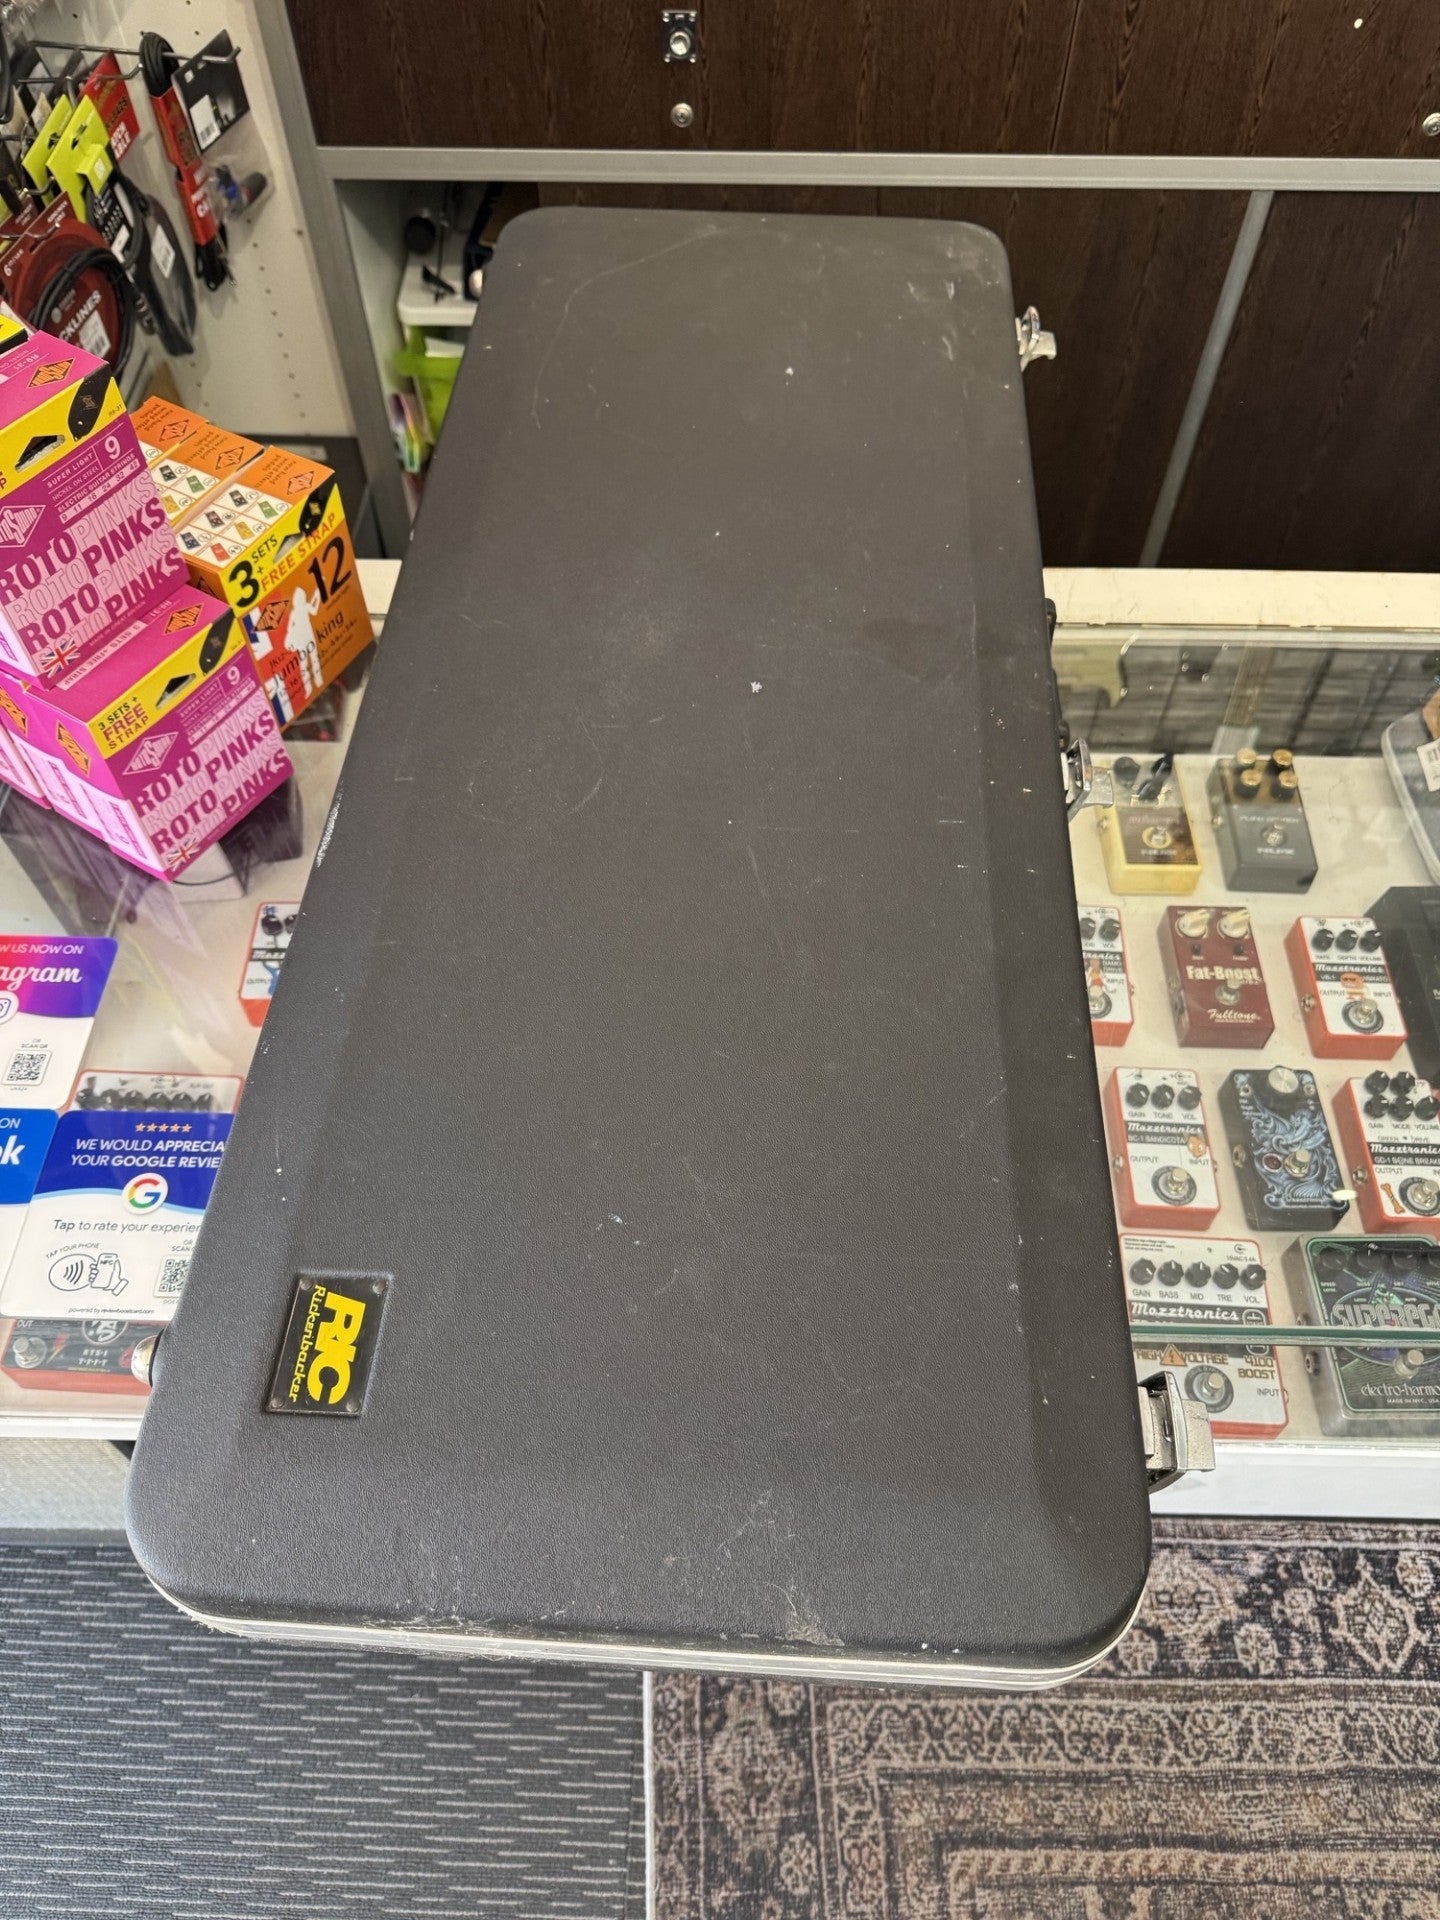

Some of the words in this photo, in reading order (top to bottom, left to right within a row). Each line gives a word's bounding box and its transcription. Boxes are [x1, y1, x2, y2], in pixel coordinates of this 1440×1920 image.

[104, 436, 121, 460] 9
[47, 468, 72, 488] SUPER
[72, 452, 94, 470] LIGHT
[52, 484, 74, 501] NICKEL
[73, 477, 82, 487] ON
[82, 465, 100, 481] STEEL
[58, 487, 89, 512] ELECTRIC
[88, 471, 111, 494] GUITAR
[110, 453, 136, 476] STRINGS
[88, 493, 97, 503] 16
[101, 482, 112, 493] 24
[115, 472, 126, 482] 32
[129, 460, 139, 471] 42
[81, 496, 166, 578] PINKS
[261, 554, 296, 592] FREE
[299, 512, 335, 560] STRAP
[0, 530, 77, 605] ROTO
[105, 547, 184, 621] PINKS
[228, 560, 260, 608] 3
[251, 533, 278, 564] SETS
[308, 536, 352, 604] 12
[17, 583, 100, 655] ROTO
[273, 640, 315, 686] jumbo
[316, 610, 345, 643] king
[227, 666, 240, 685] 9
[98, 722, 105, 731] 3
[108, 702, 130, 723] SETS
[103, 703, 146, 742] FREE
[109, 715, 149, 750] STRAP
[205, 710, 275, 784] PINKS
[134, 752, 201, 817] ROTO
[221, 748, 289, 816] PINKS
[151, 790, 218, 853] ROTO
[11, 944, 29, 954] US
[28, 944, 61, 954] NOW
[62, 945, 84, 954] ON
[1186, 965, 1261, 981] Fat-Boost
[1207, 1009, 1258, 1020] Fulltone
[0, 1118, 20, 1128] ON
[72, 1155, 110, 1167] YOUR
[111, 1156, 175, 1168] GOOGLE
[179, 1157, 221, 1168] REVIE
[76, 1139, 98, 1150] WE
[100, 1139, 152, 1151] WOULD
[155, 1140, 225, 1152] APPRECIA
[53, 1220, 75, 1230] Tap
[79, 1221, 91, 1230] to
[93, 1221, 118, 1231] rate
[120, 1223, 149, 1232] your
[59, 1243, 78, 1255] YOUR
[1131, 1302, 1239, 1321] Mozztronics
[1132, 1289, 1151, 1298] GAIN
[1159, 1290, 1179, 1299] BASS
[1190, 1292, 1204, 1300] MID
[1217, 1294, 1232, 1303] TRE
[1243, 1295, 1260, 1304] VOL
[17, 1320, 33, 1328] OUT
[289, 1284, 326, 1403] Rickenbacker
[307, 1291, 366, 1404] RIC
[1136, 1349, 1162, 1361] HIGH
[1183, 1353, 1229, 1365] VOLTAGE
[1238, 1368, 1275, 1379] BOOST
[1257, 1388, 1280, 1397] INPUT
